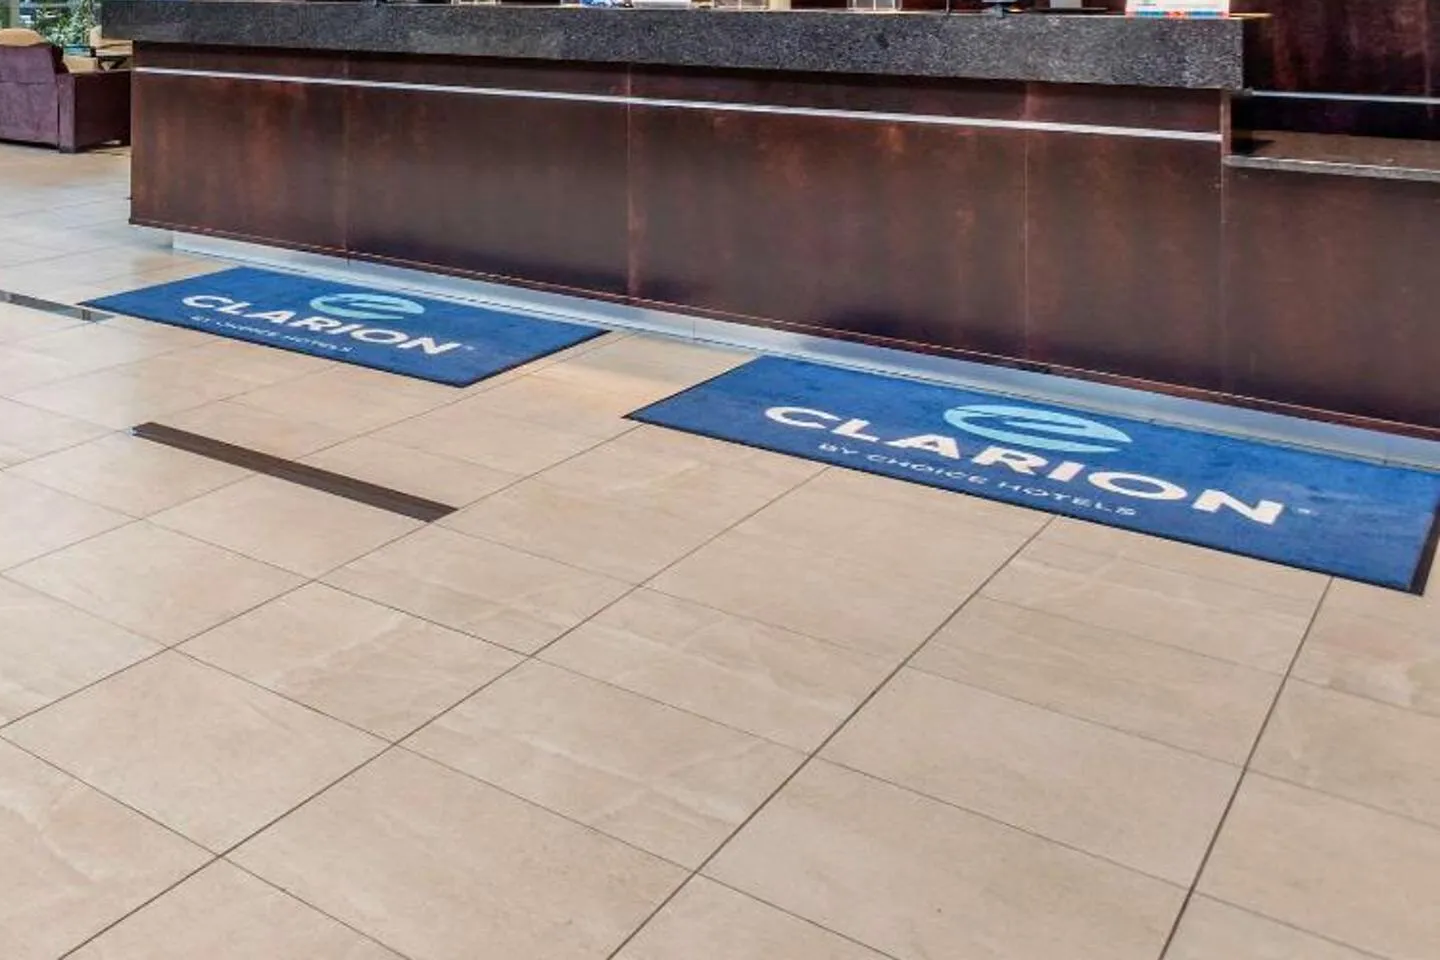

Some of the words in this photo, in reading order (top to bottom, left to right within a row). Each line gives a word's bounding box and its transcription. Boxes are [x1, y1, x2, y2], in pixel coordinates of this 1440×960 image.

[182, 295, 462, 355] CLARION
[765, 406, 1284, 525] CLARION
[818, 442, 859, 454] BY
[865, 453, 988, 484] CHOICE
[998, 481, 1137, 516] HOTELS
